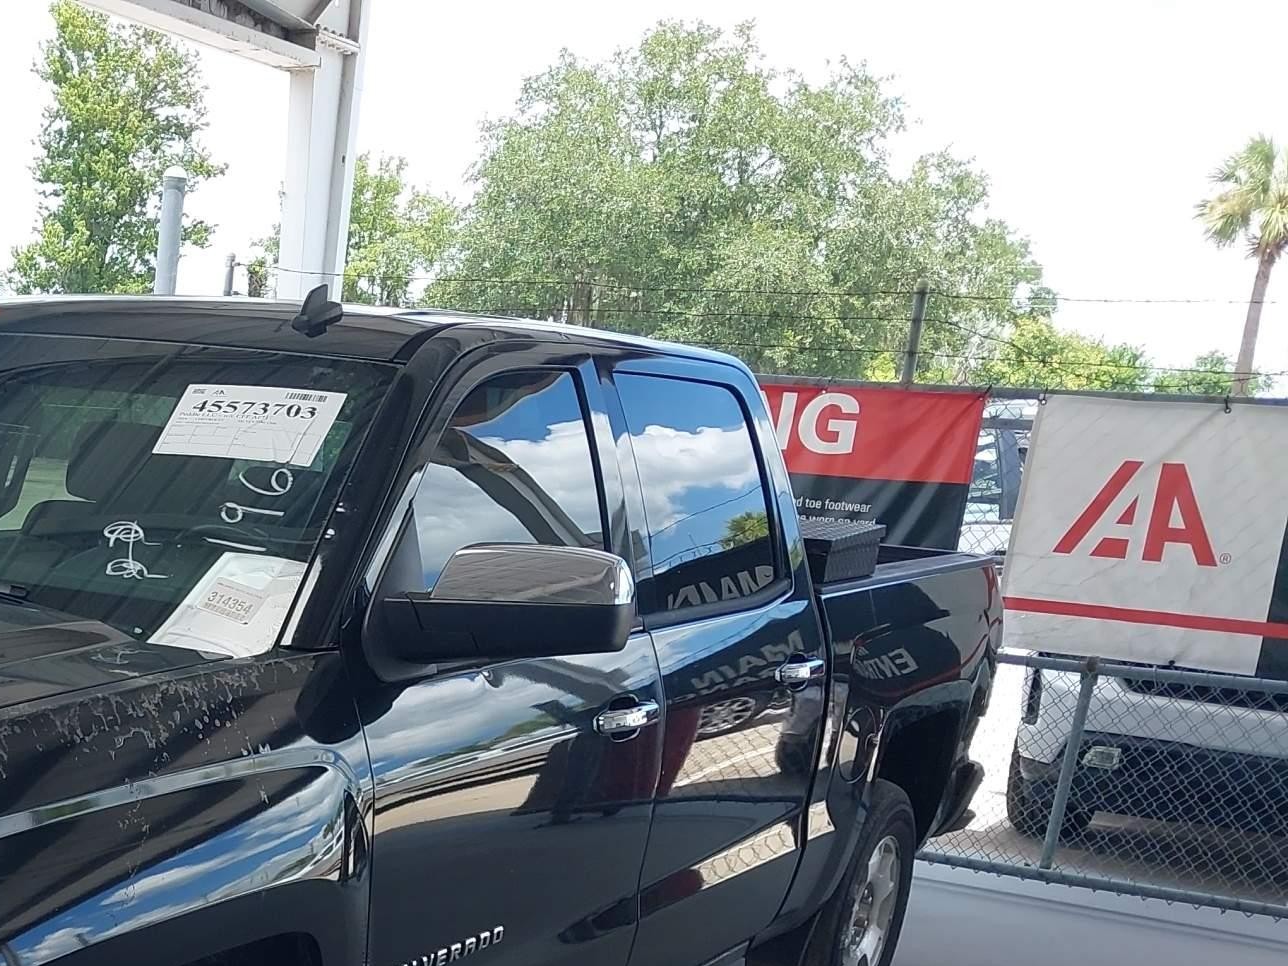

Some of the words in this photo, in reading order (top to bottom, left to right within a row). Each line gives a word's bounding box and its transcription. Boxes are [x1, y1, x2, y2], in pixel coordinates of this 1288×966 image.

[192, 400, 319, 421] 45573703
[805, 498, 822, 509] toe
[824, 498, 872, 514] footwear
[207, 591, 254, 615] 314354
